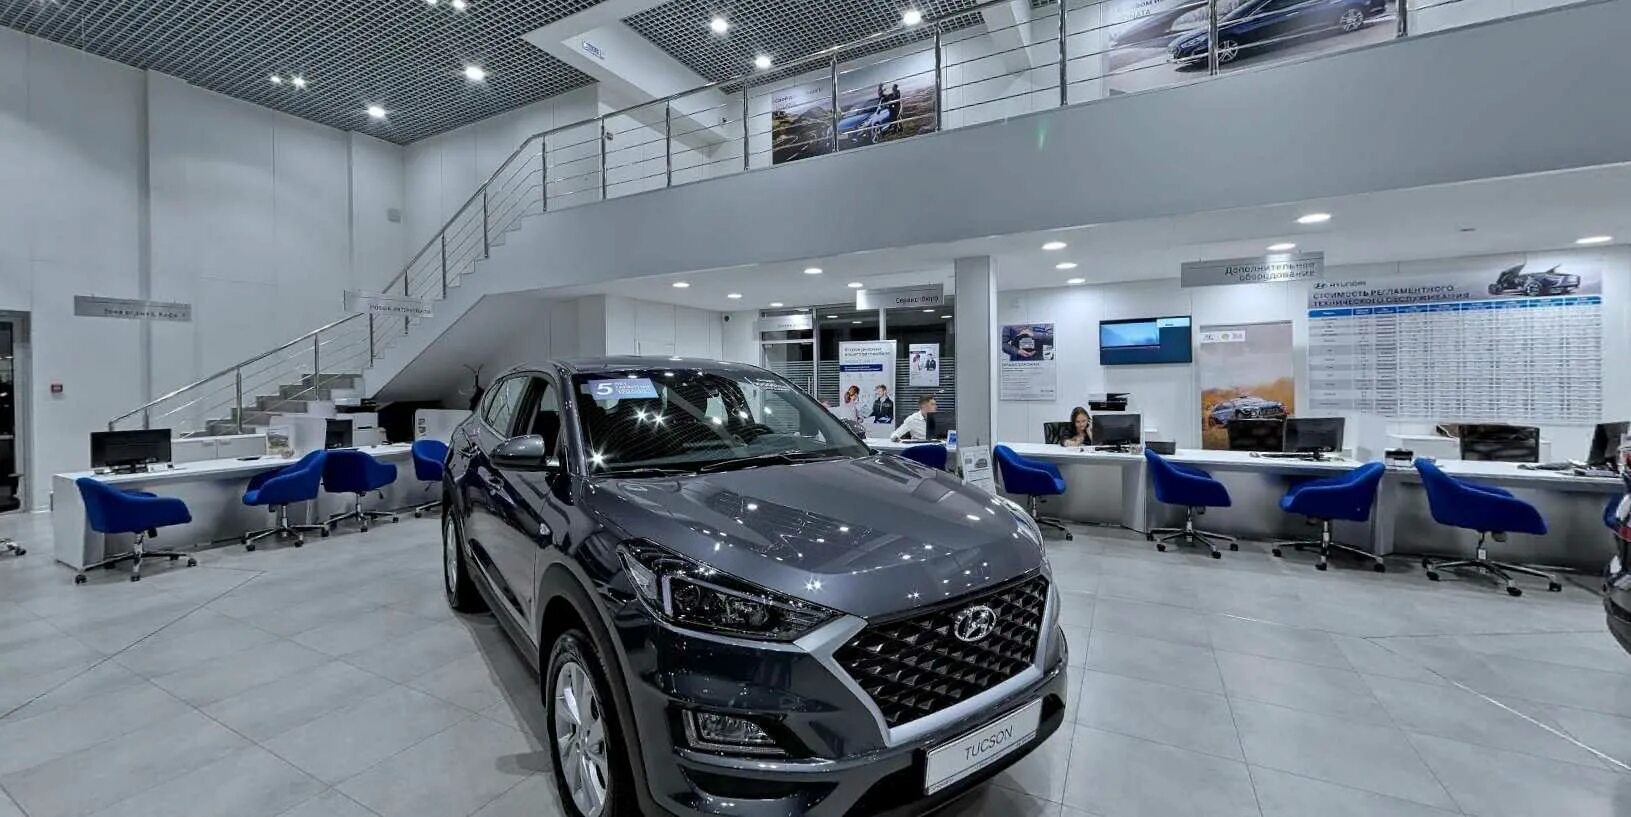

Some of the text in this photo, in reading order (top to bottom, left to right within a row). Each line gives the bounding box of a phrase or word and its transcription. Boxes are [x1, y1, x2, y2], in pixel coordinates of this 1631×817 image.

[1225, 262, 1315, 276] Дополнительное
[1313, 284, 1454, 299] СТОИМОСТЬ РЕГЛАМЕНТНОГО
[1313, 297, 1384, 307] ТЕХНИЧЕСКОГО
[596, 383, 613, 395] 5
[965, 724, 1013, 760] TUCSON
